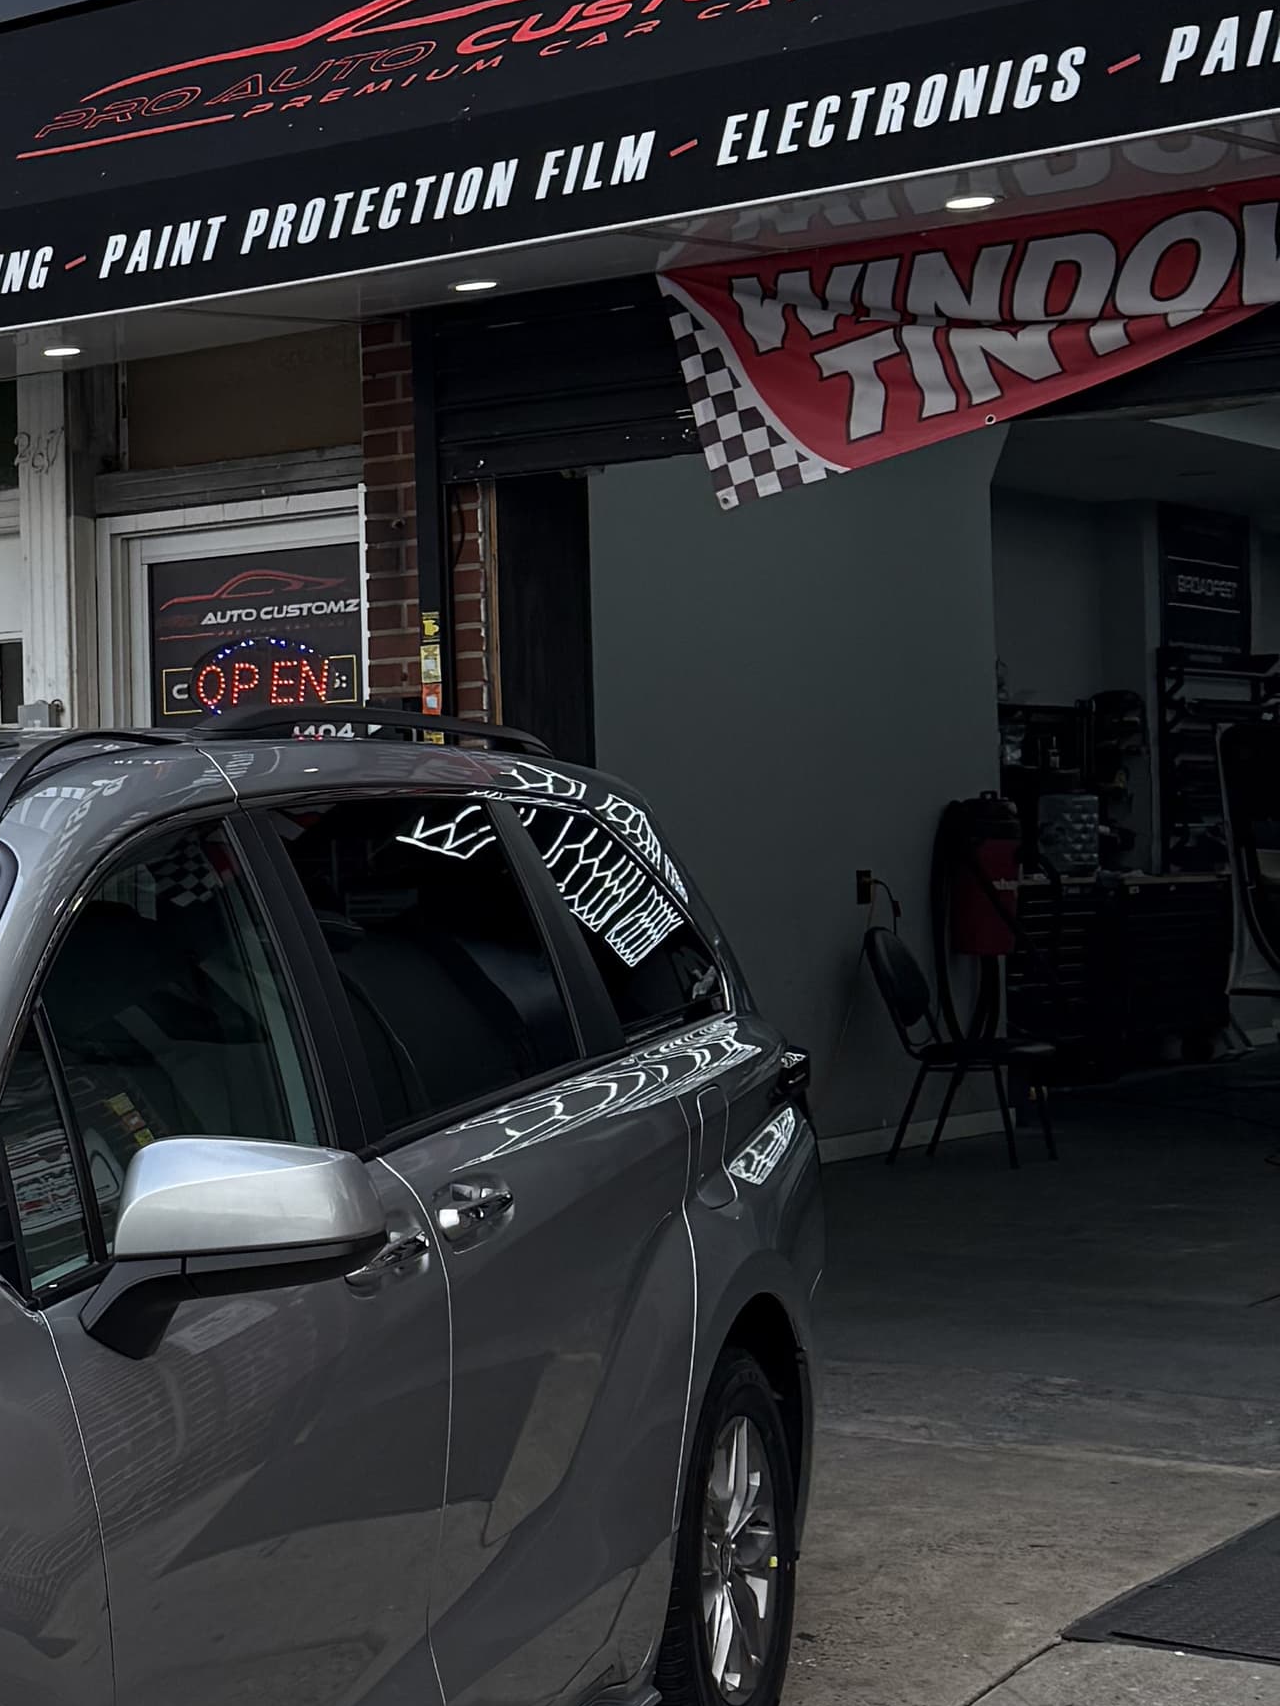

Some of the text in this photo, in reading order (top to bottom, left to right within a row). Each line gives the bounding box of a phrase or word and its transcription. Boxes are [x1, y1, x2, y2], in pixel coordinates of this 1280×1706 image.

[35, 85, 202, 141] PRO
[205, 39, 437, 109] AUTO
[242, 55, 506, 119] PREMIUM
[538, 20, 663, 58] CAR
[97, 215, 227, 280] PAINT
[246, 156, 519, 250] PROTECTION
[535, 129, 657, 202] FILM
[716, 45, 1088, 168] ELECTRONICS
[1160, 9, 1280, 84] PAI
[200, 607, 257, 626] AUTO
[259, 597, 361, 621] CUSTOMZ
[196, 659, 330, 706] OPEN
